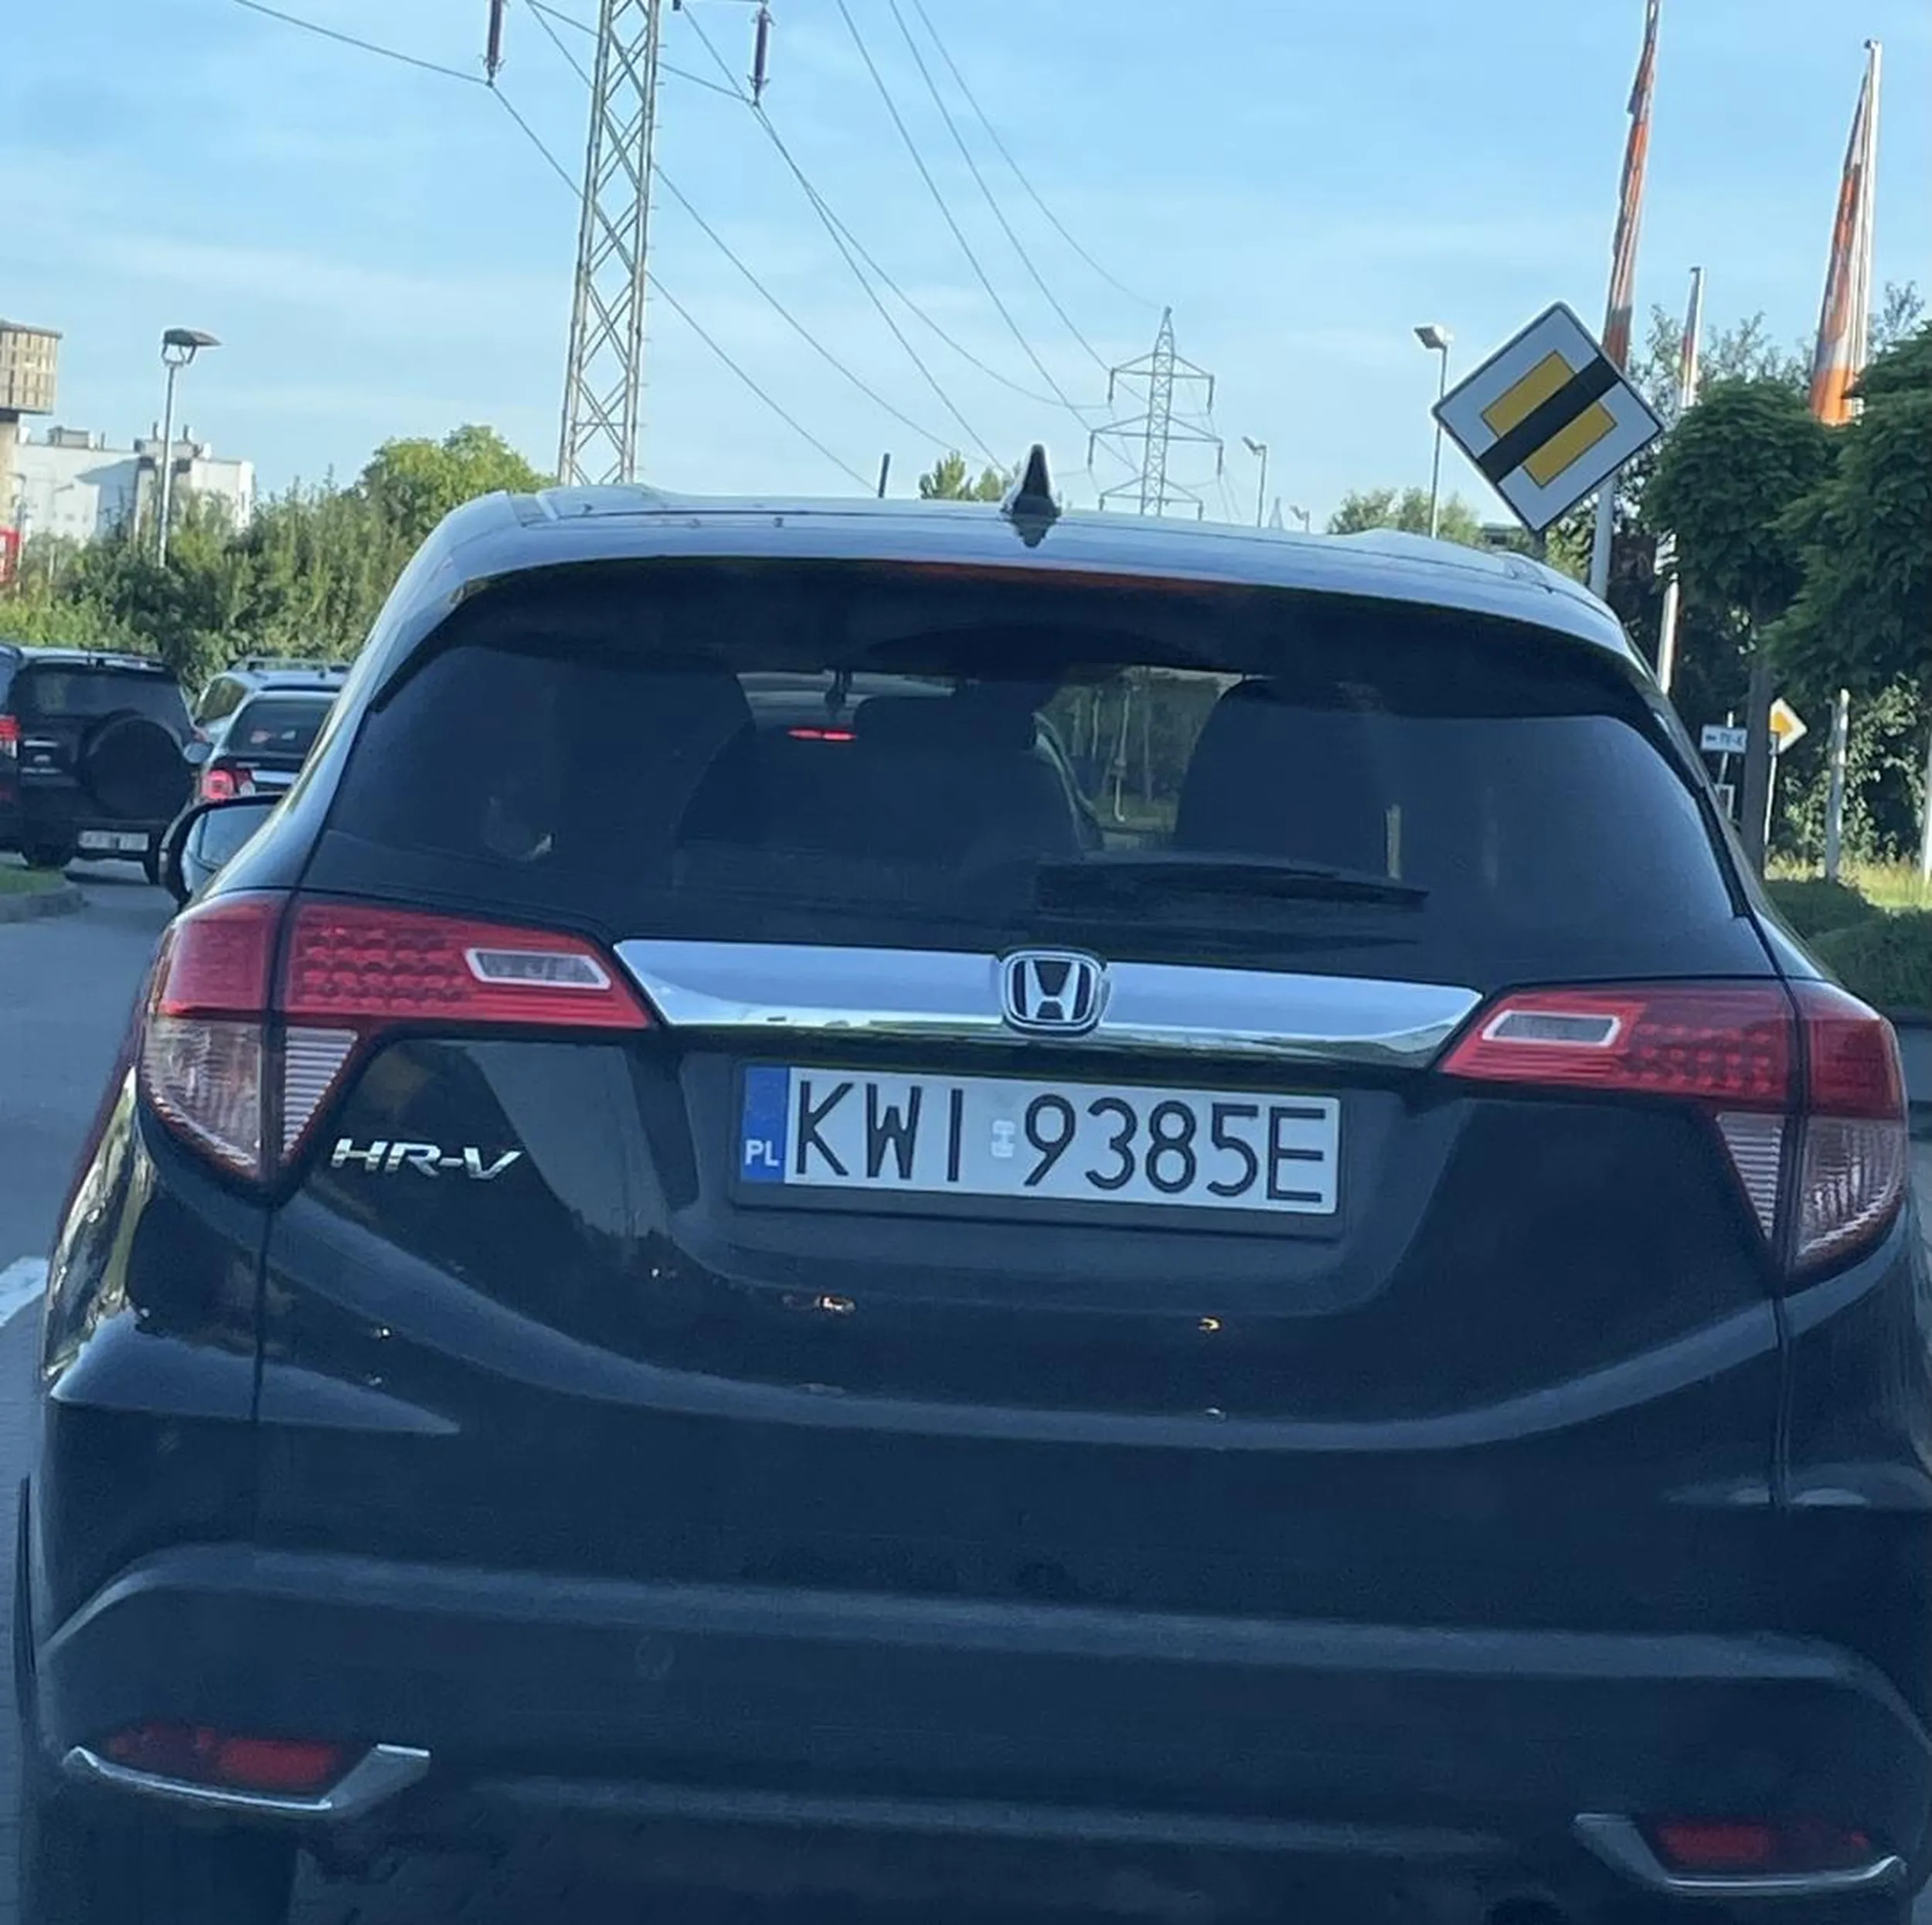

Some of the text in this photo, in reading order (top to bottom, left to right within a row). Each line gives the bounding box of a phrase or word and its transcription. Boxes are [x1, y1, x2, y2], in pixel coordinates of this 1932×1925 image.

[330, 1138, 523, 1180] HR-V
[745, 1139, 780, 1167] PL
[796, 1080, 1326, 1203] KWI 9385E
